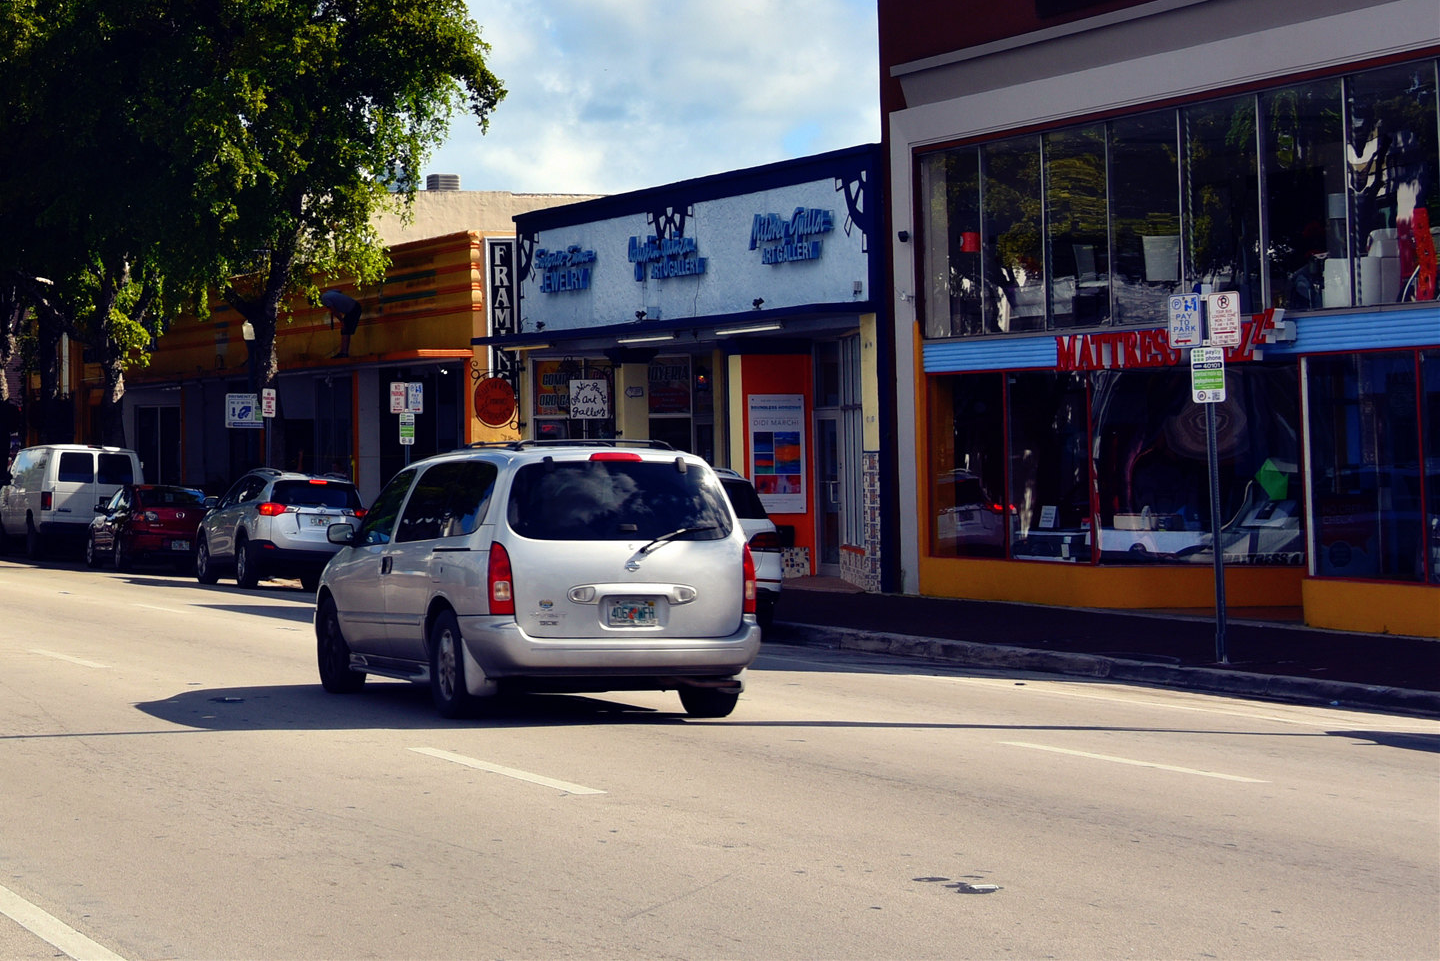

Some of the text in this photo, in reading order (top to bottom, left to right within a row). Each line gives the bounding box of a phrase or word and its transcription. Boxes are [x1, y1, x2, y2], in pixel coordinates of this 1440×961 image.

[776, 241, 820, 262] GALLERY
[668, 257, 705, 277] GALLERY
[540, 268, 589, 293] JEWELRY
[494, 245, 513, 386] FRAMN
[1056, 328, 1181, 371] MATTRESS
